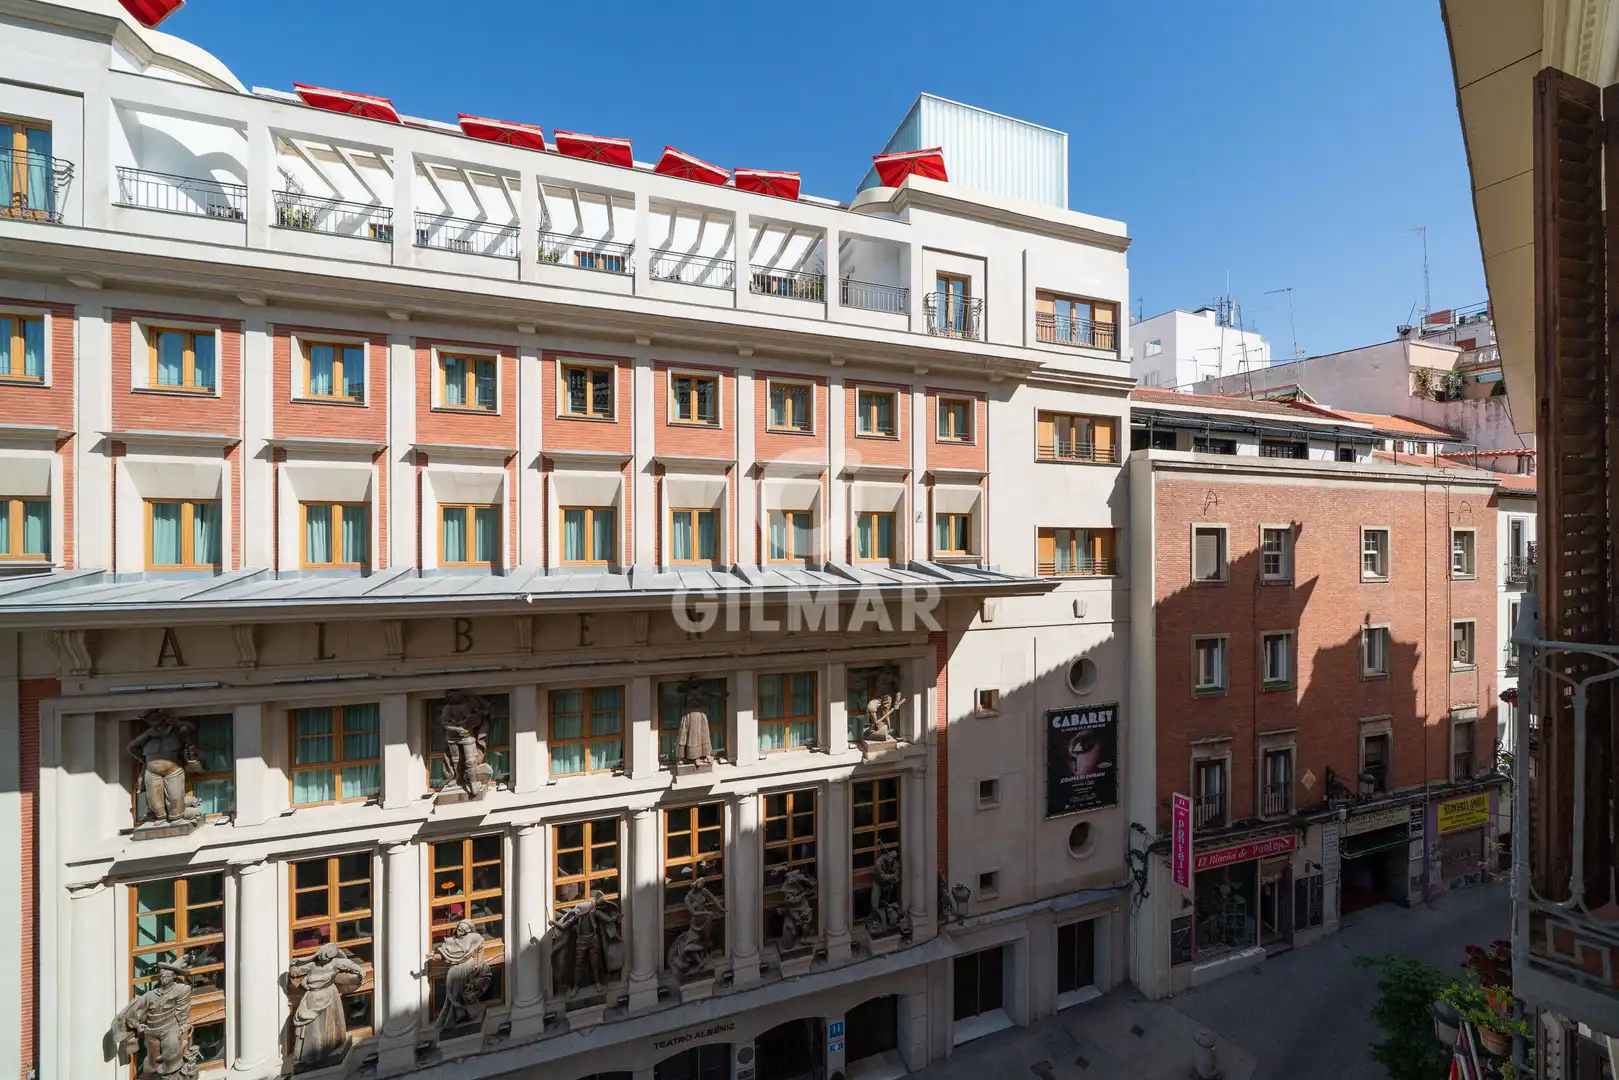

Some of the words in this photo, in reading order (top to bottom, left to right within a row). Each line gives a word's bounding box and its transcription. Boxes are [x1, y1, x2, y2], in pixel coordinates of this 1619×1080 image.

[1052, 710, 1113, 728] CABARET
[1238, 848, 1248, 858] de
[653, 1034, 693, 1049] TEATRO
[694, 1022, 736, 1040] ALBÉNIZ
